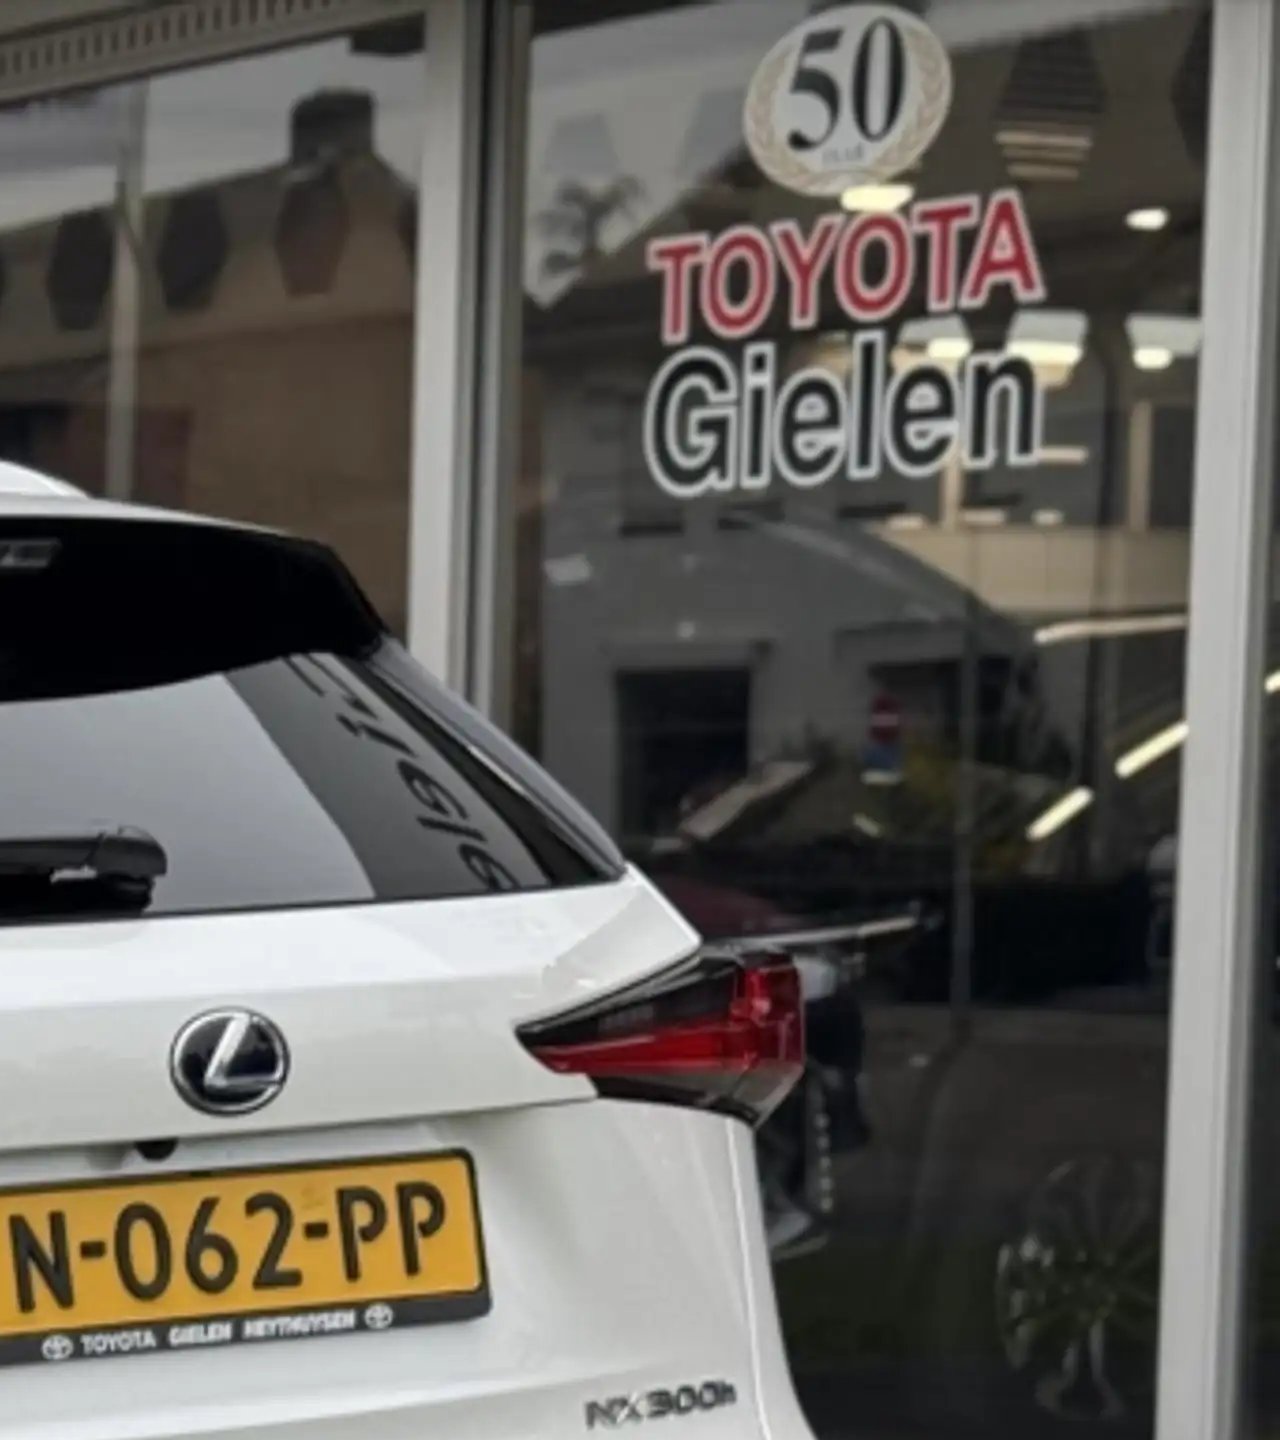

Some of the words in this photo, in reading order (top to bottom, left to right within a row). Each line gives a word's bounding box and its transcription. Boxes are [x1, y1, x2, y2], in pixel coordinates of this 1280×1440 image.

[786, 15, 907, 152] 50
[647, 189, 1046, 345] TOYOTA
[643, 331, 1042, 497] Gielen
[7, 1179, 448, 1314] N-062-PP
[81, 1329, 156, 1355] TOYOTA
